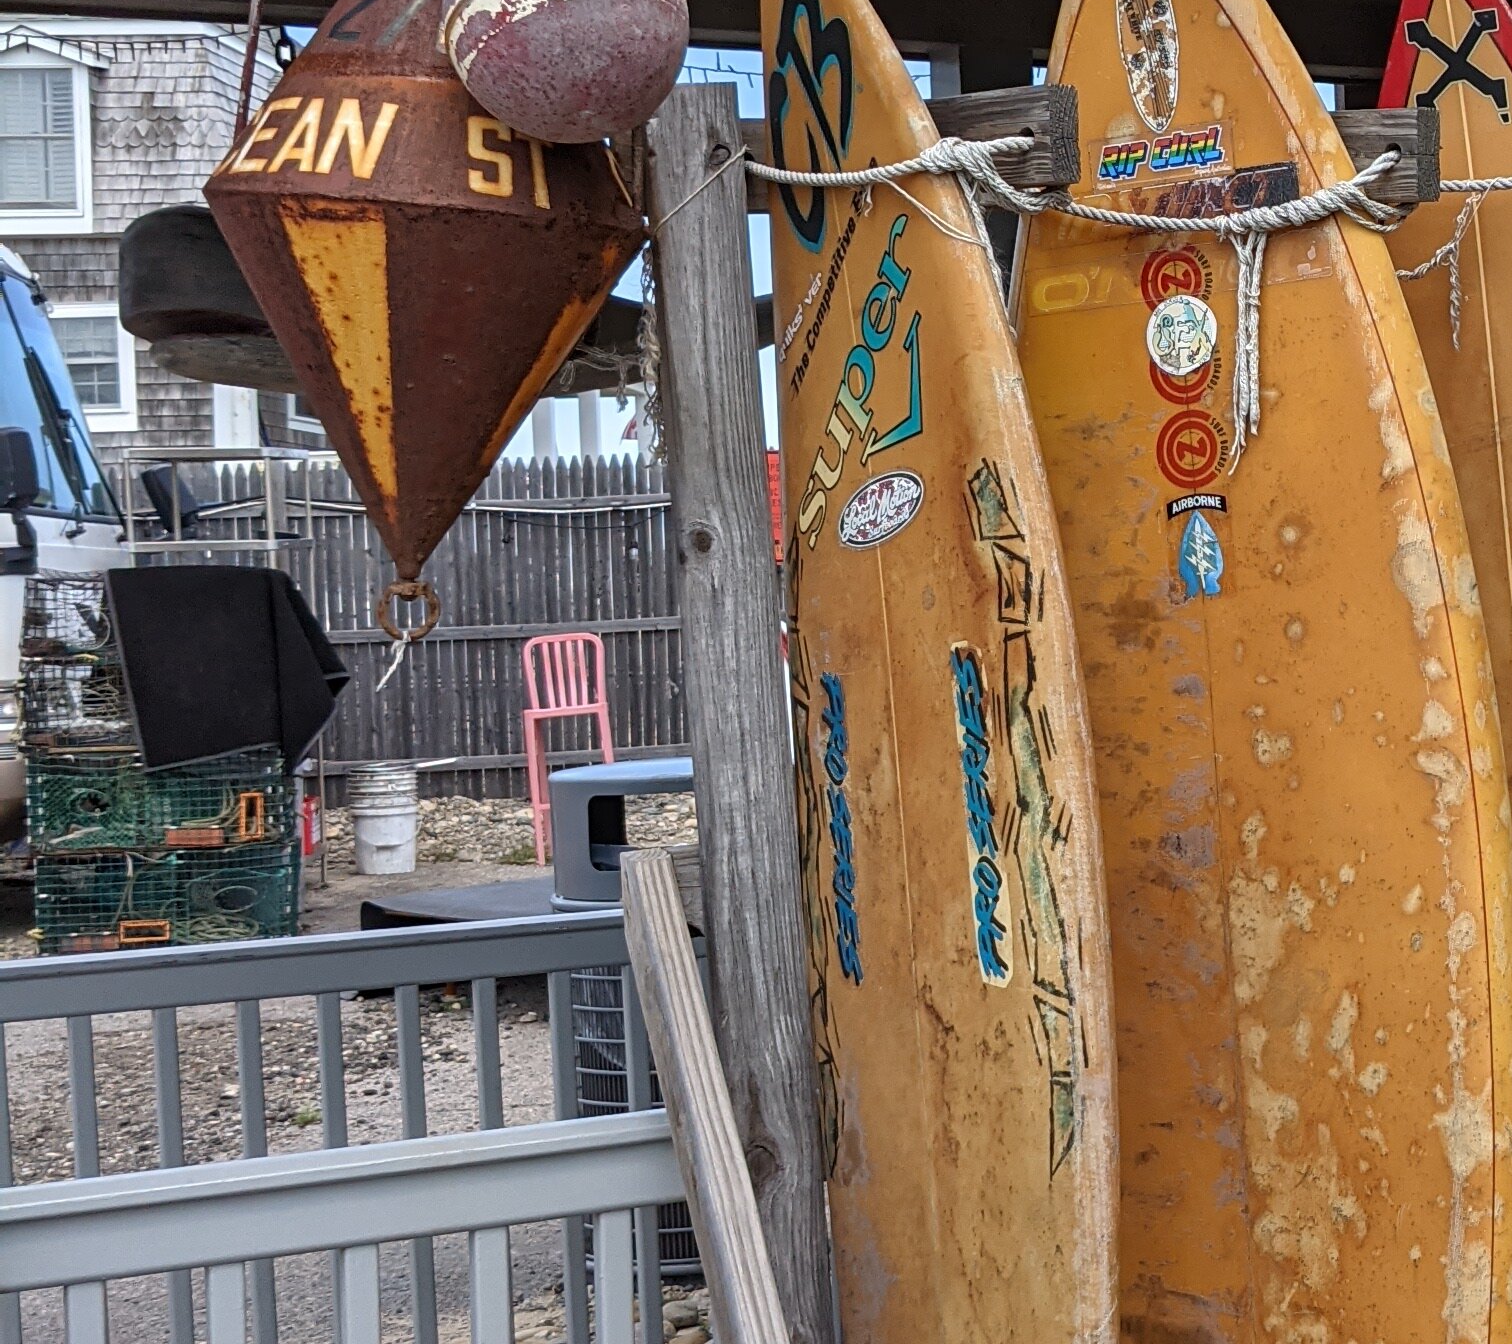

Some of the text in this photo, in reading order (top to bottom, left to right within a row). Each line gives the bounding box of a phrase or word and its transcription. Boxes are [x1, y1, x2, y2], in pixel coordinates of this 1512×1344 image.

[213, 96, 400, 179] EAN
[1098, 125, 1226, 181] RIP CURL
[790, 356, 811, 398] The
[805, 214, 858, 349] Competitive
[799, 213, 911, 551] Super
[1214, 439, 1229, 474] BOARDS
[841, 481, 921, 543] Local Motion
[1171, 495, 1222, 515] AIRBORNE
[820, 671, 864, 986] PRO SERIES
[949, 645, 1009, 981] PRO SERIES
